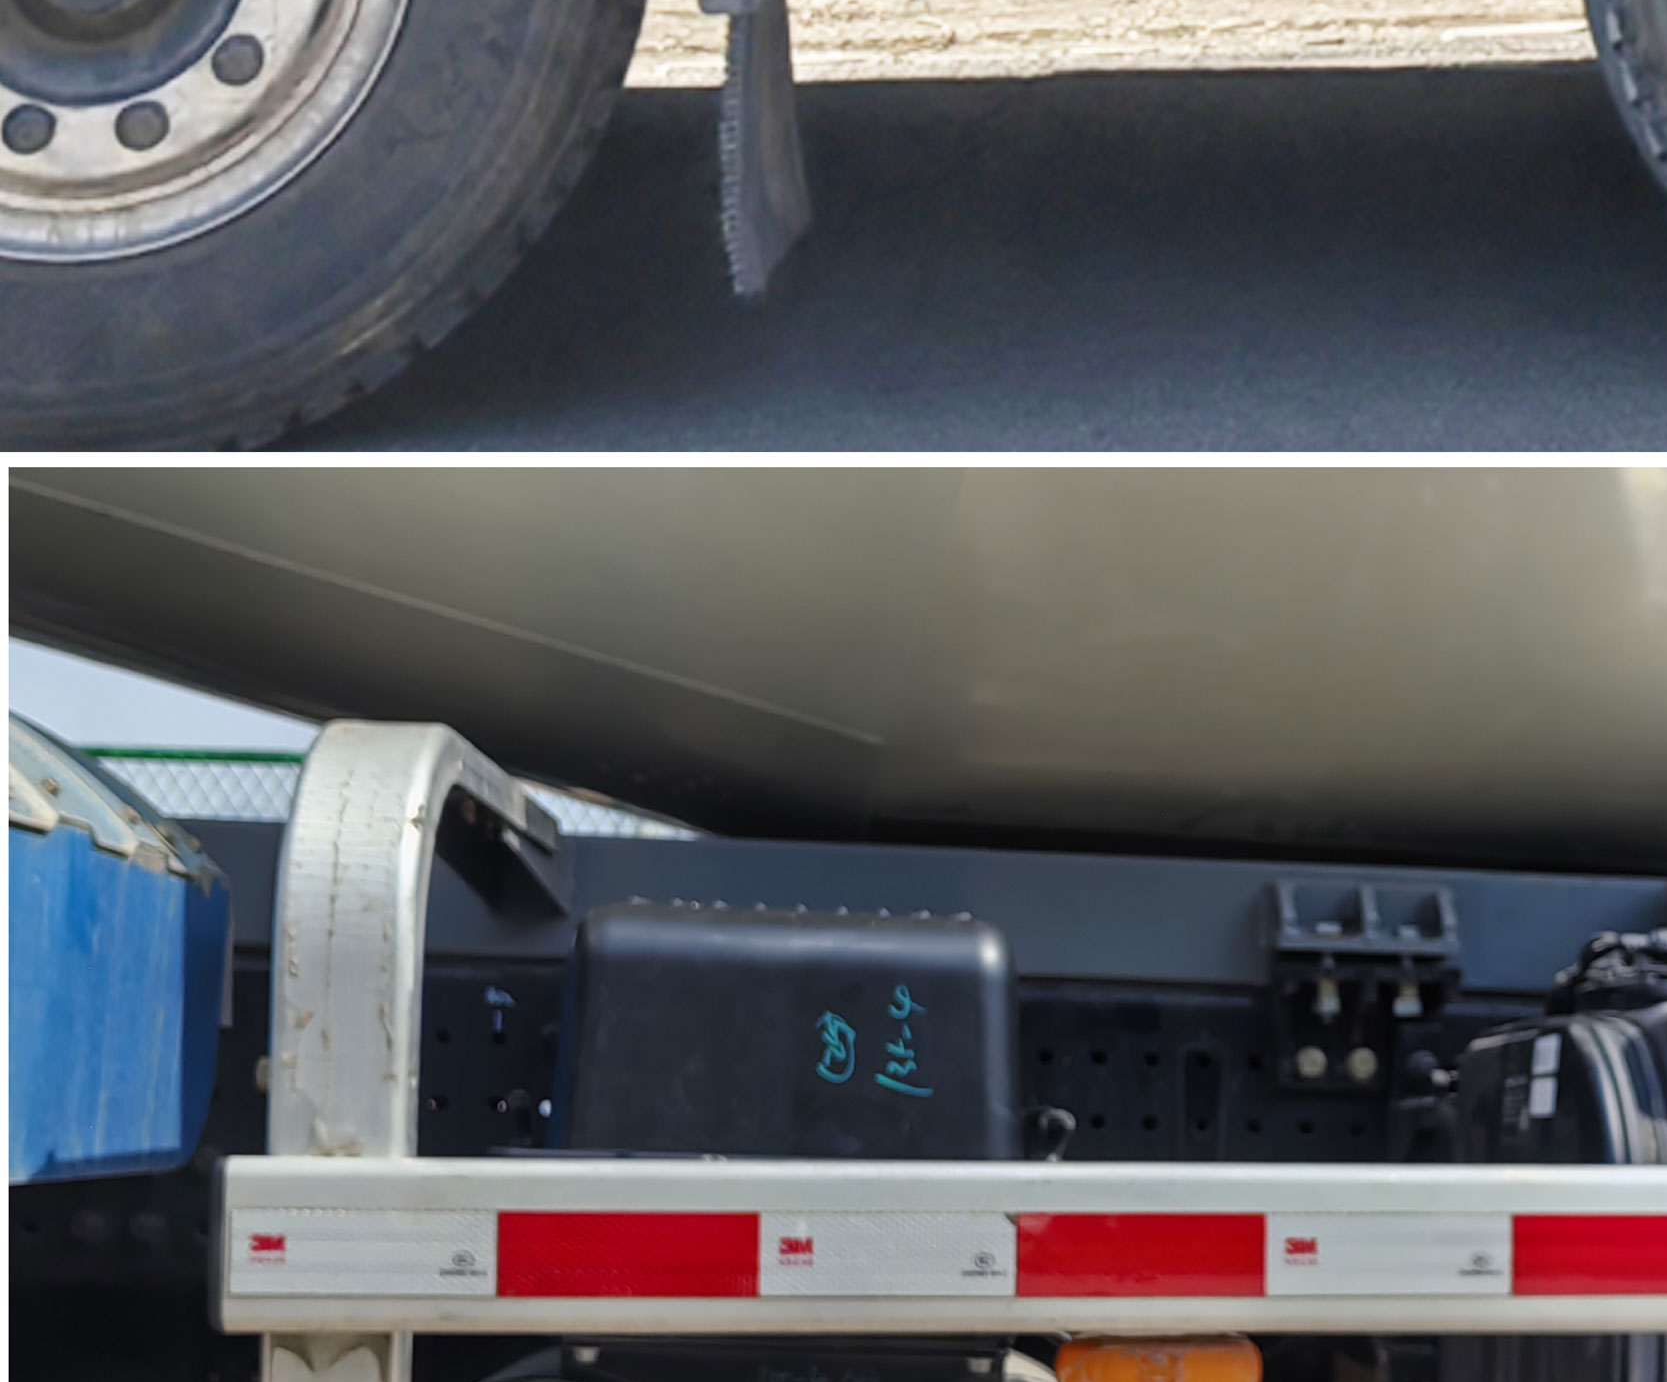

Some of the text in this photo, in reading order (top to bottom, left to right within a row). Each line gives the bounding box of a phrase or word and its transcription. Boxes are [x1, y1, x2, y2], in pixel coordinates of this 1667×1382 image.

[250, 1234, 285, 1251] 3M
[779, 1238, 813, 1254] 3M
[1286, 1238, 1316, 1254] 3M
